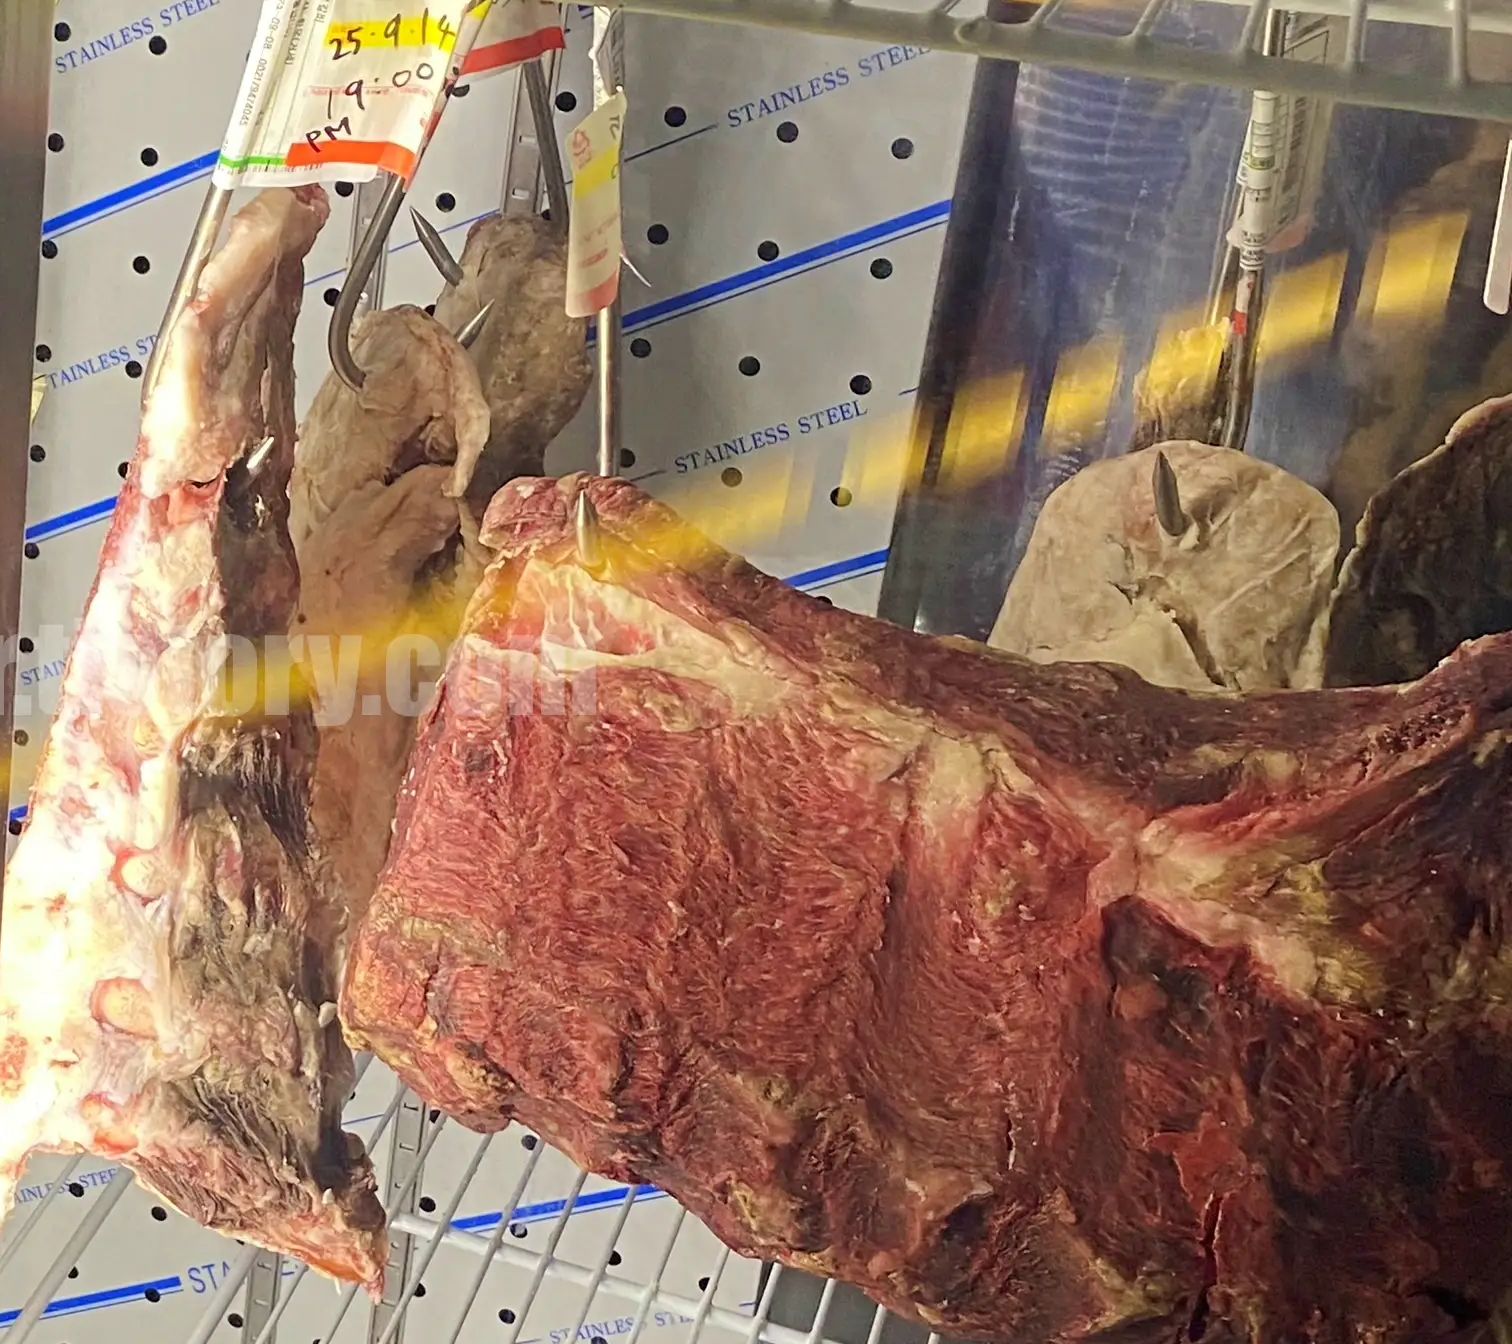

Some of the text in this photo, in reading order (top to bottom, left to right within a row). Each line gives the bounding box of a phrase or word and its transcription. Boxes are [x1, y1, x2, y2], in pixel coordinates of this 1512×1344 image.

[55, 17, 155, 74] STAINLESS
[727, 67, 850, 128] STAINLESS
[48, 346, 131, 389] TAINLESS
[674, 400, 869, 474] STAINLESS STEEL
